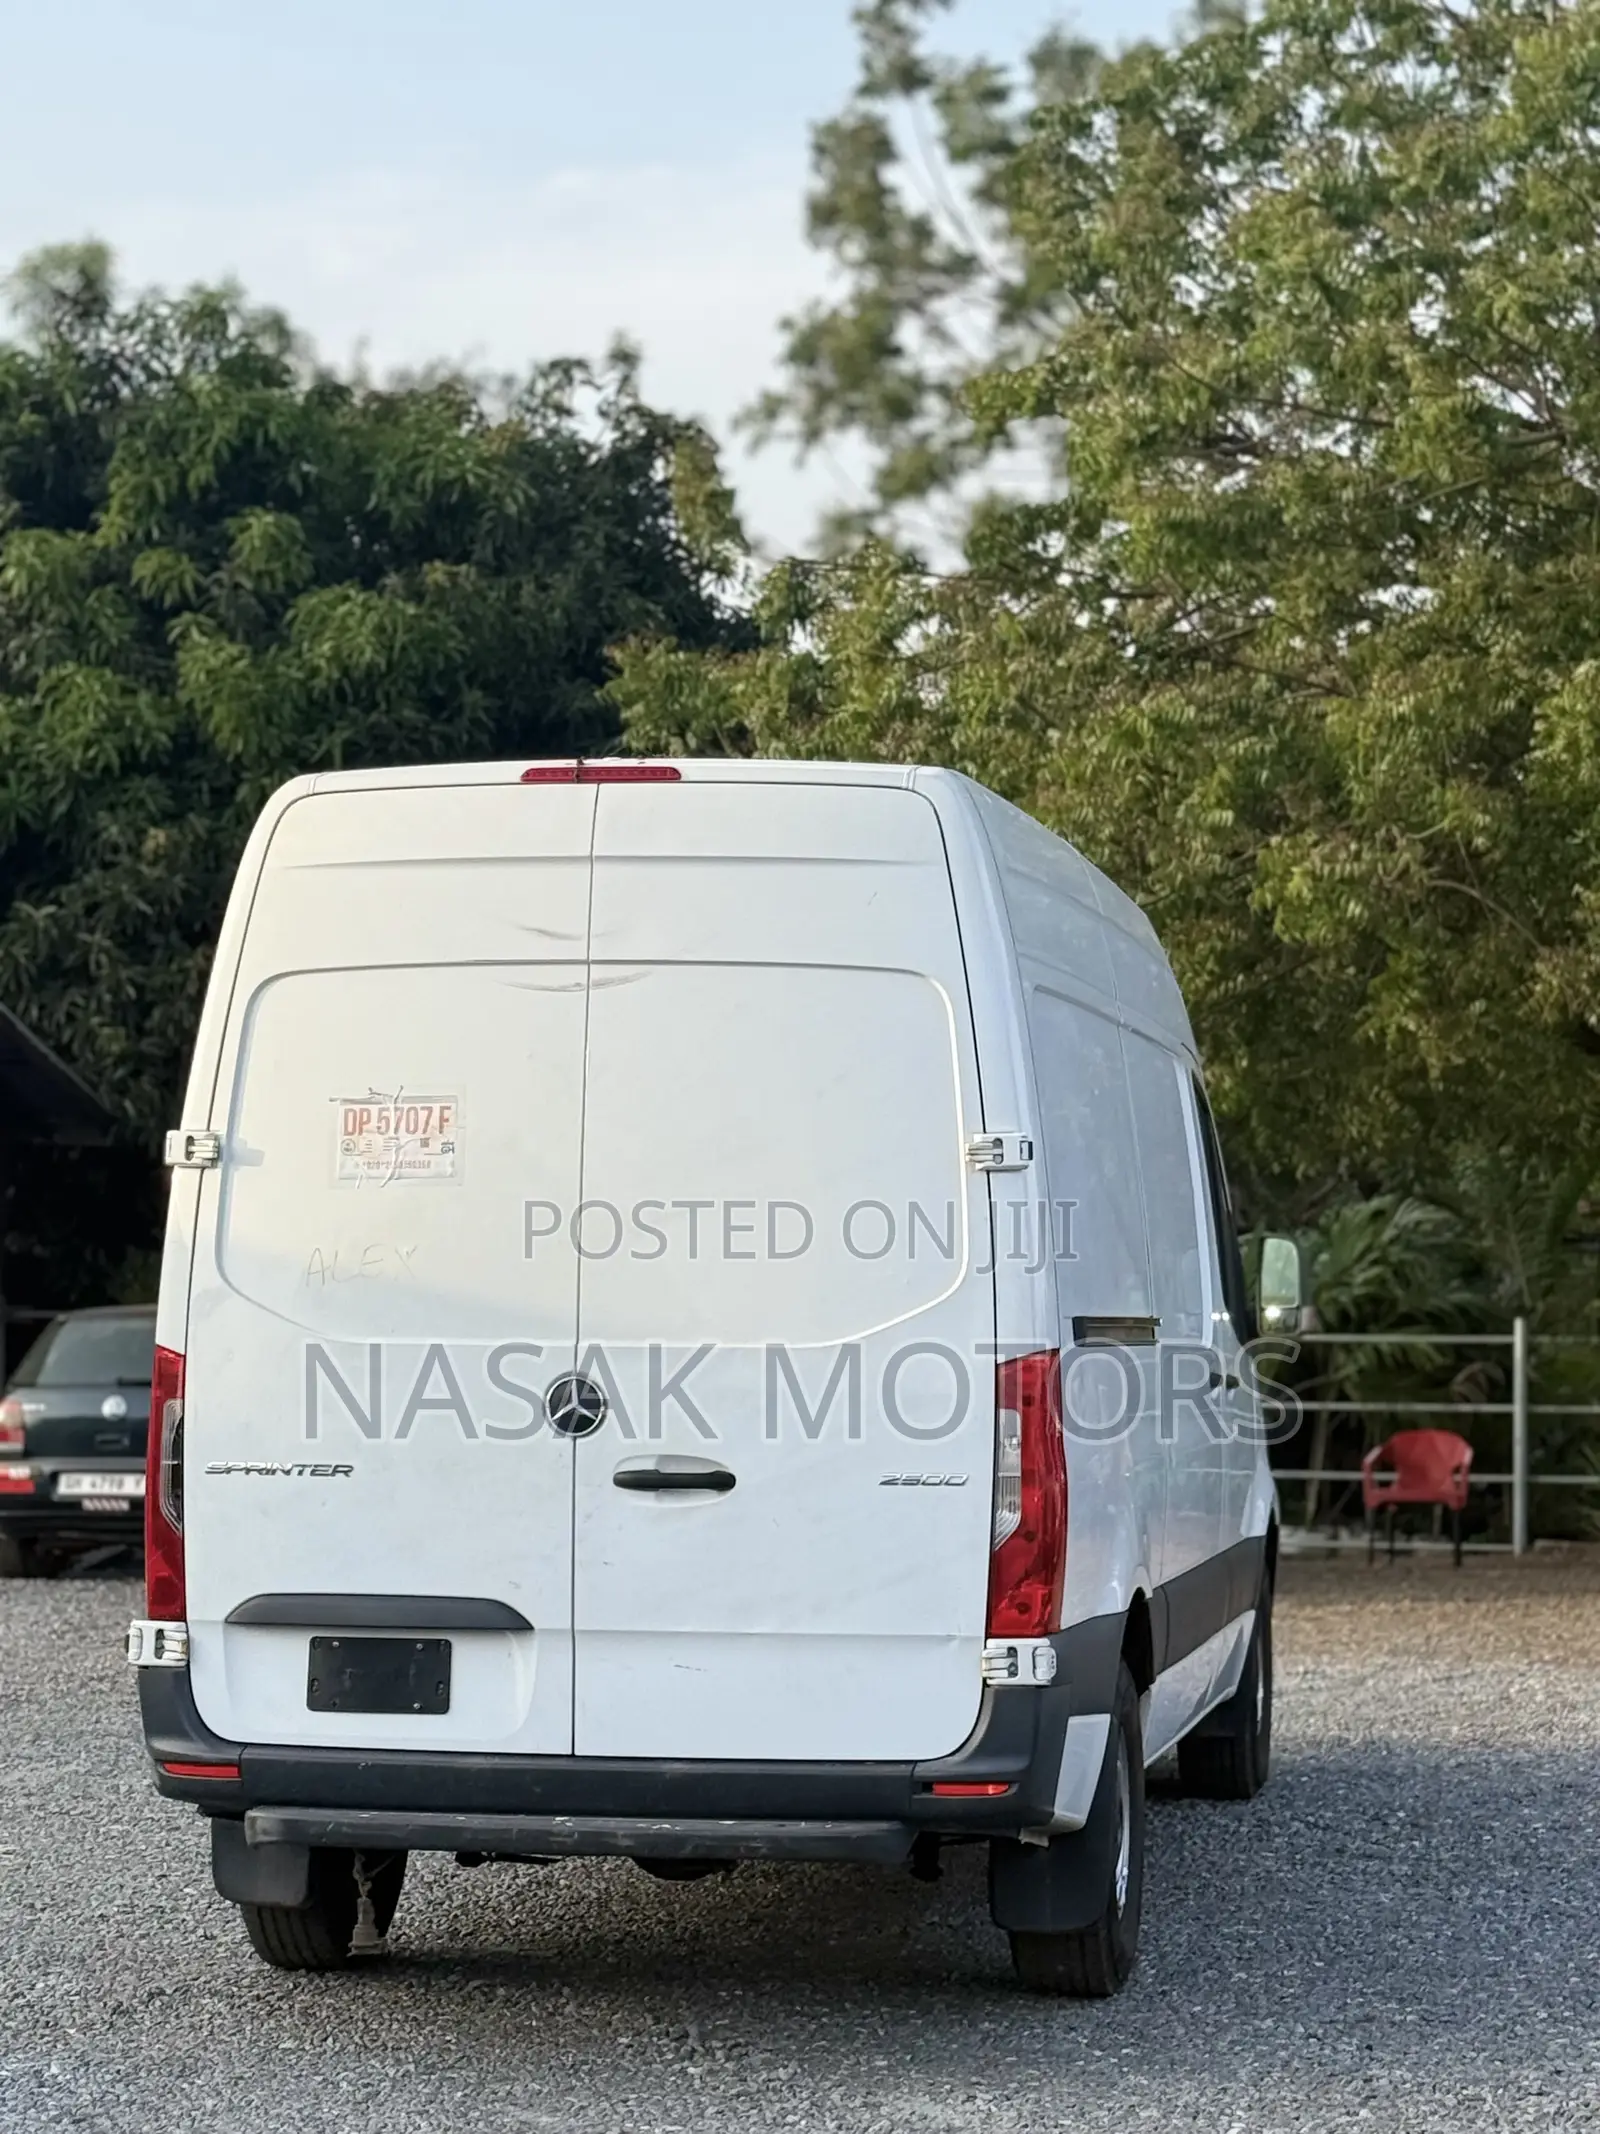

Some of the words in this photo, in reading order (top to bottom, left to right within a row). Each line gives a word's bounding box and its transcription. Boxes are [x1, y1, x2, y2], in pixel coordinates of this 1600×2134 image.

[343, 1107, 372, 1136] DP
[376, 1105, 433, 1136] 5707
[438, 1105, 452, 1135] F
[306, 1243, 418, 1287] ALEX
[204, 1460, 355, 1477] SPRINTER
[878, 1472, 969, 1486] 2500
